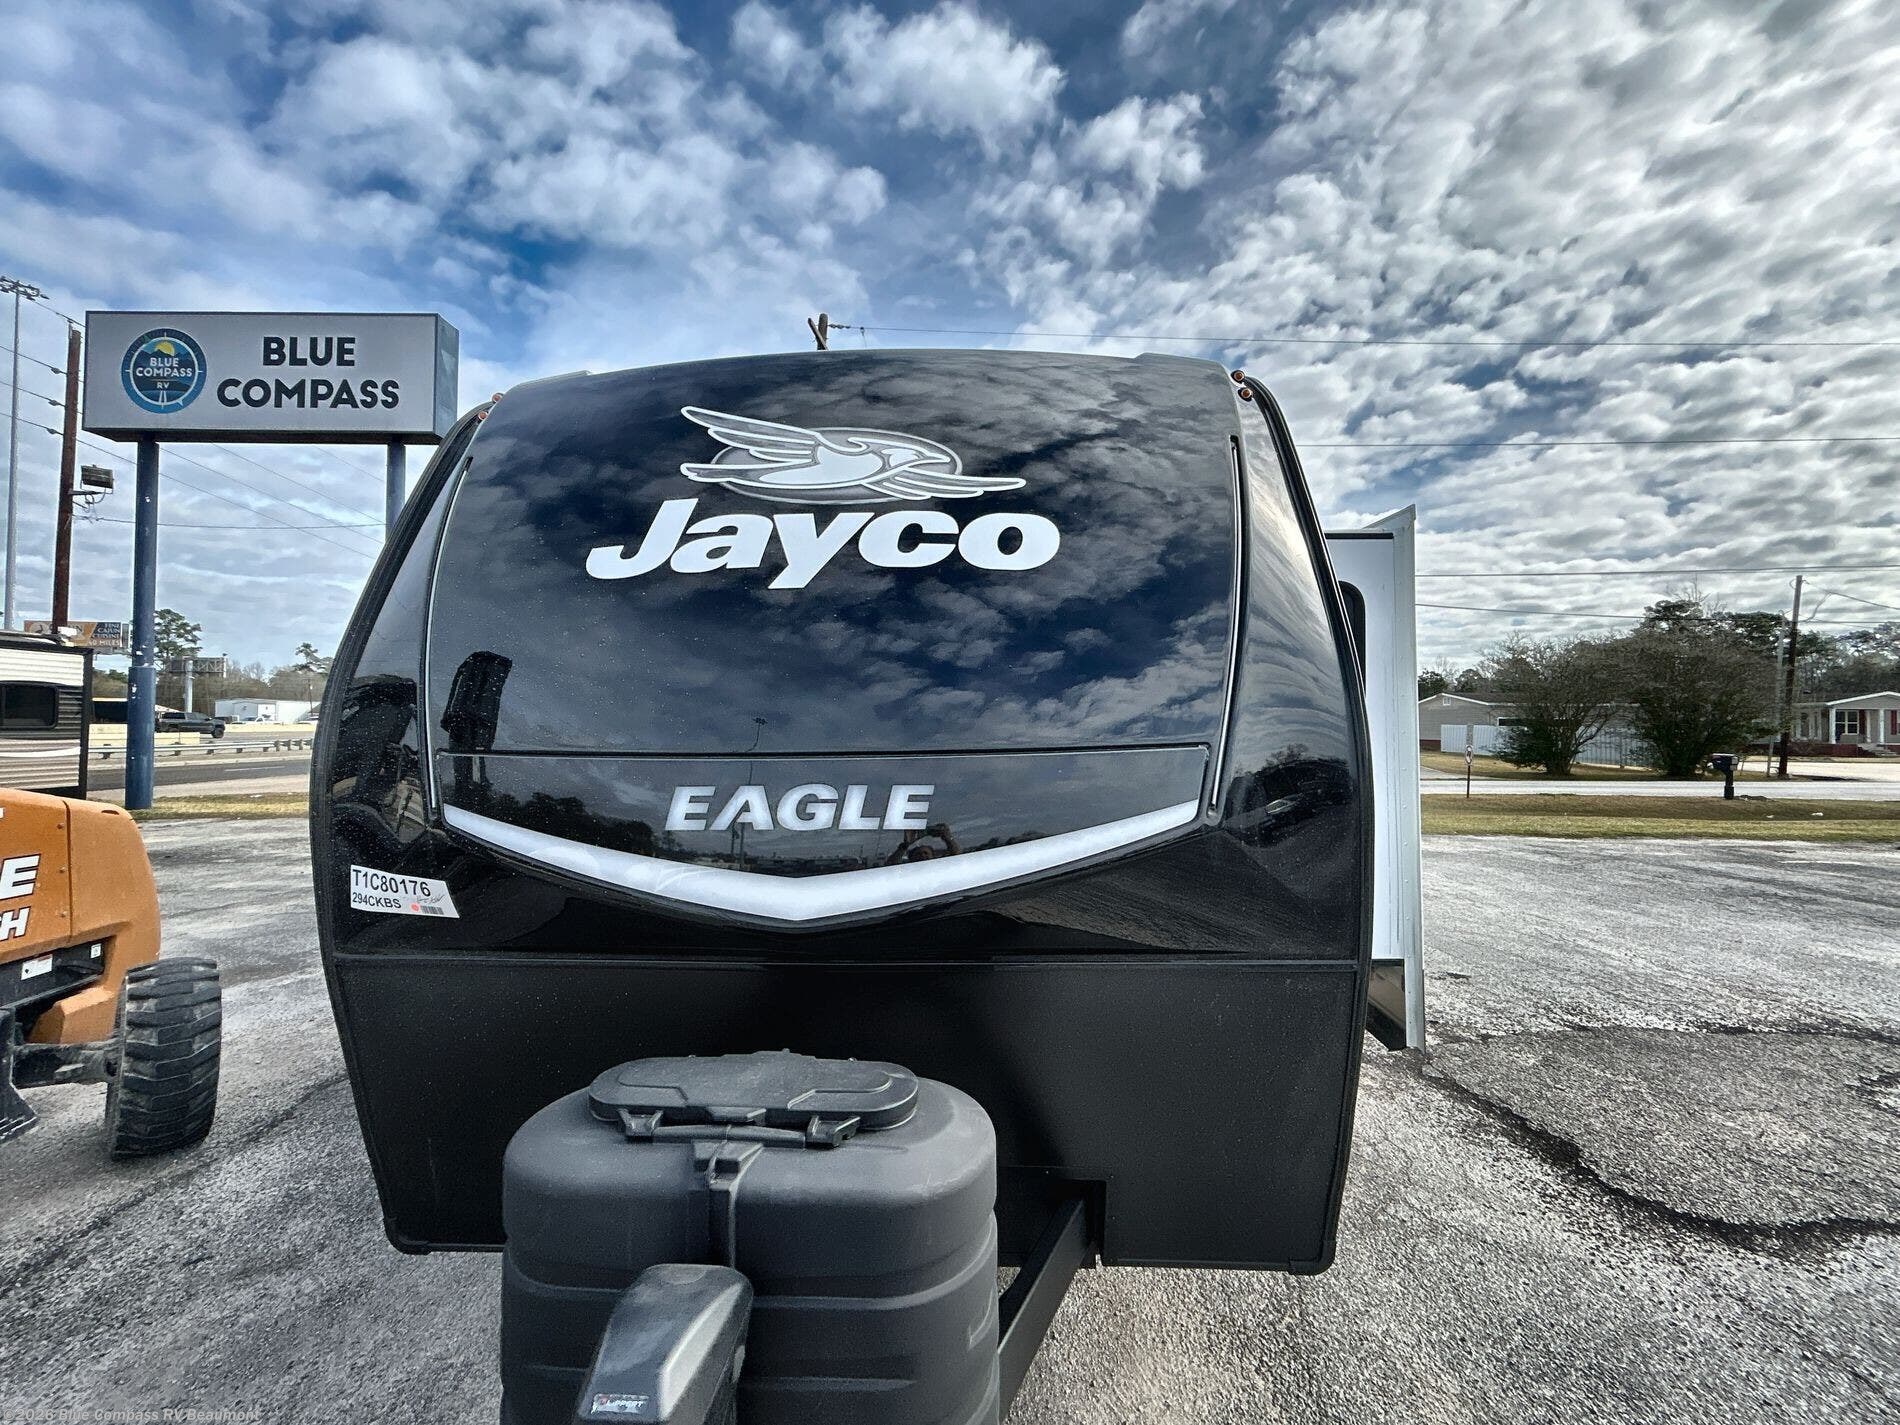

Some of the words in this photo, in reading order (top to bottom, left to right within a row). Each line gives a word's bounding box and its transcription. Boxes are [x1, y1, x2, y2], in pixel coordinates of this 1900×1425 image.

[149, 357, 180, 367] BLUE
[262, 336, 356, 367] BLUE
[135, 367, 193, 377] COMPASS
[216, 378, 400, 409] COMPASS
[585, 498, 1061, 590] Jayco
[664, 783, 935, 831] EAGLE
[352, 869, 431, 897] T1C80176
[352, 892, 402, 909] 294CKBS
[0, 906, 31, 940] H
